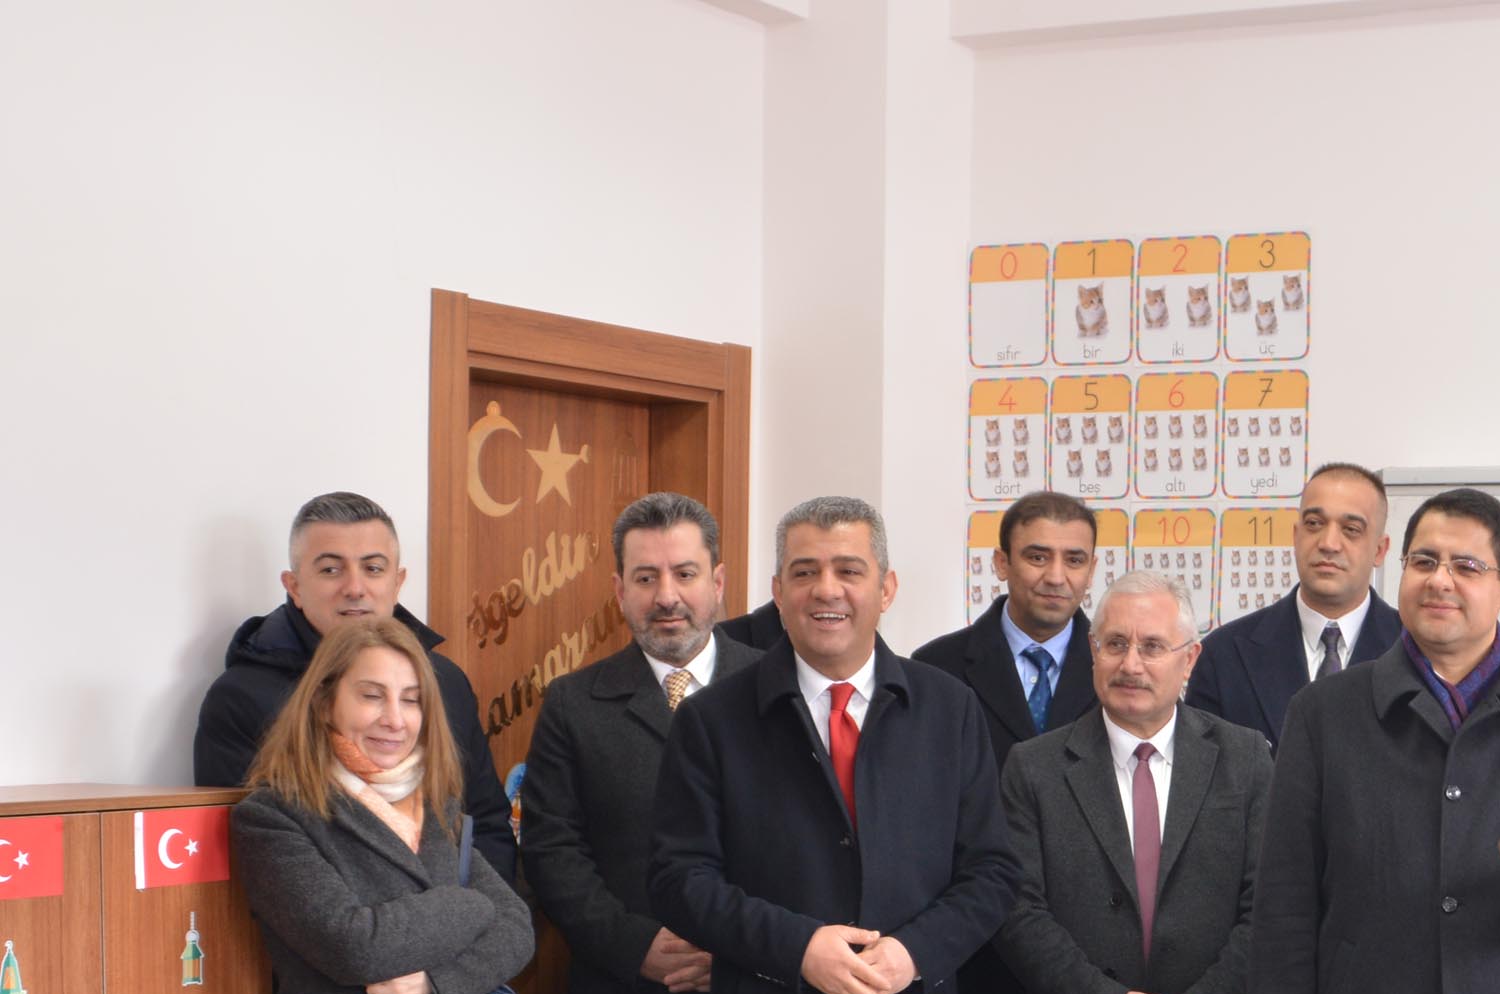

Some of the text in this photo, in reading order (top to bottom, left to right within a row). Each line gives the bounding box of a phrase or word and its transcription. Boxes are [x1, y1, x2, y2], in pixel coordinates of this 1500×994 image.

[1000, 250, 1018, 280] 0
[1087, 247, 1097, 276] 1
[1171, 243, 1188, 273] 2
[1259, 239, 1276, 269] 3
[1082, 343, 1101, 360] bir
[1171, 341, 1185, 357] iki
[1258, 342, 1275, 357] üç
[997, 384, 1017, 413] 4
[1083, 381, 1099, 410] 5
[1168, 379, 1185, 408] 6
[1258, 378, 1273, 407] 7
[994, 480, 1022, 496] dört
[1079, 480, 1101, 495] beş
[1165, 478, 1186, 493] altı
[1250, 472, 1279, 495] yedi
[1157, 515, 1191, 545] 10
[1247, 515, 1274, 545] 11
